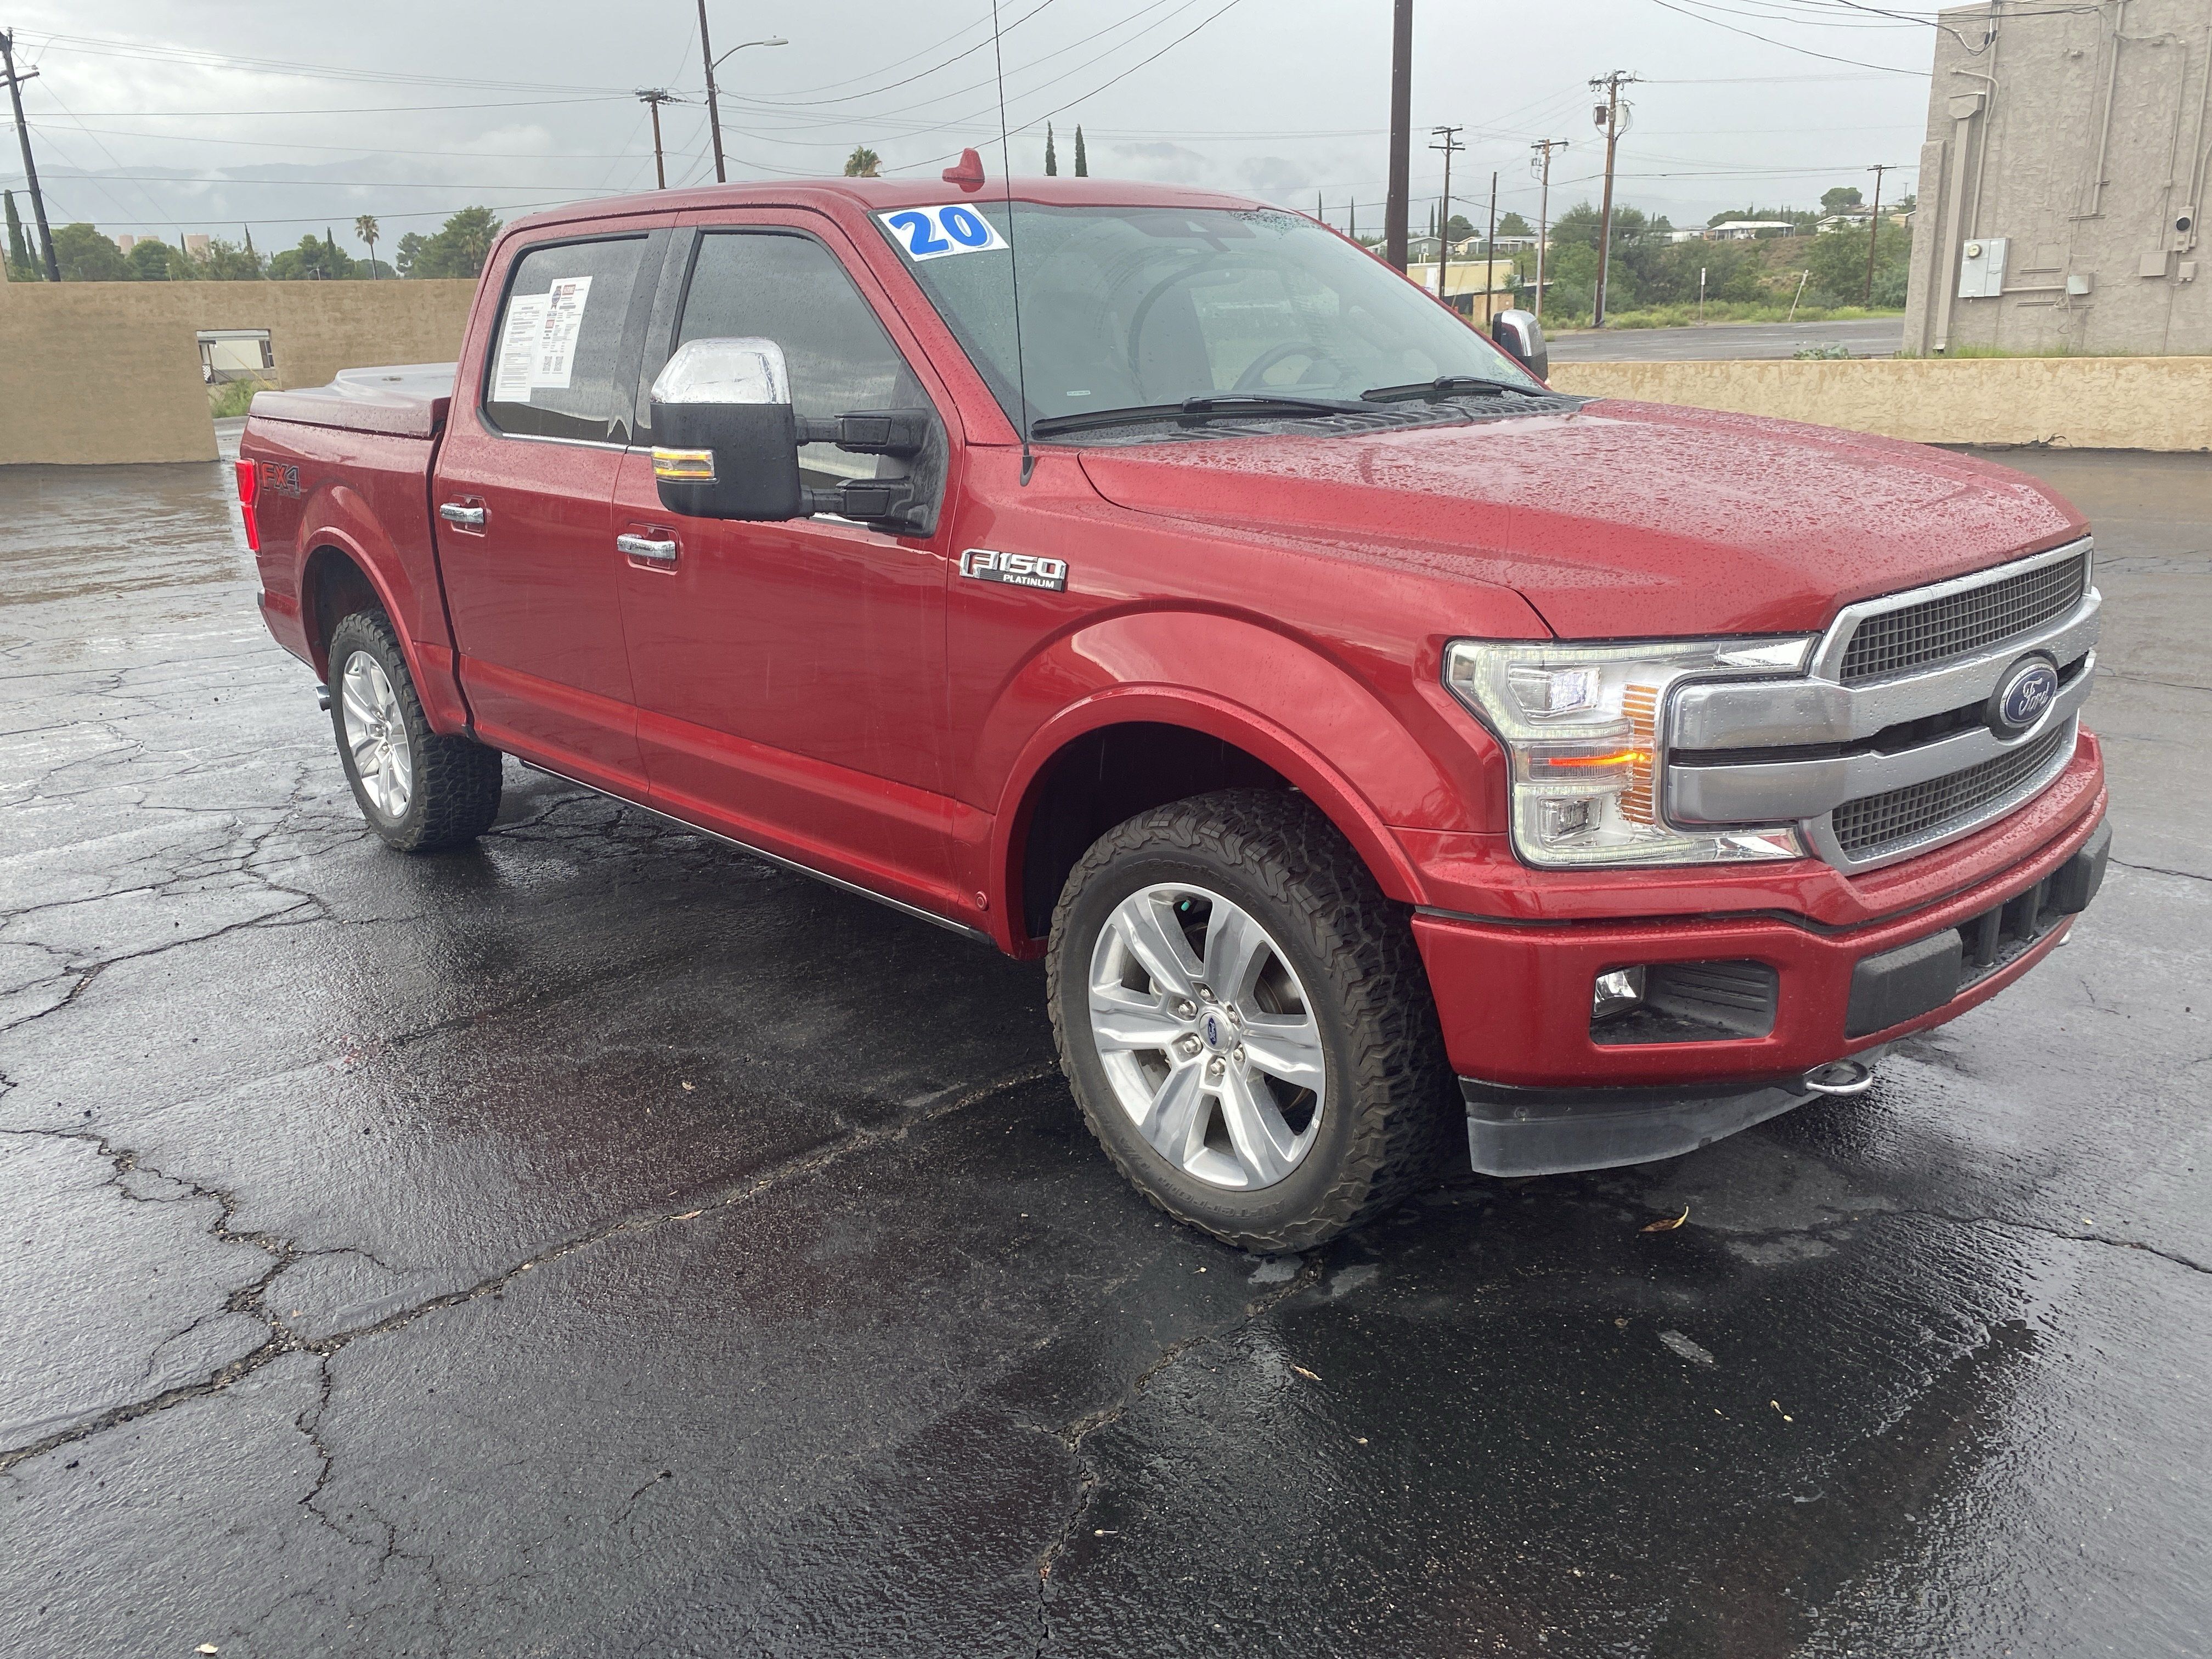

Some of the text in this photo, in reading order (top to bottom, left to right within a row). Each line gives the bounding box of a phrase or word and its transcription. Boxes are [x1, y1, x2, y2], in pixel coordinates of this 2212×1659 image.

[889, 207, 992, 255] 20
[262, 461, 301, 493] FX4
[1003, 574, 1054, 589] PLATINUM
[2018, 678, 2050, 716] Ford
